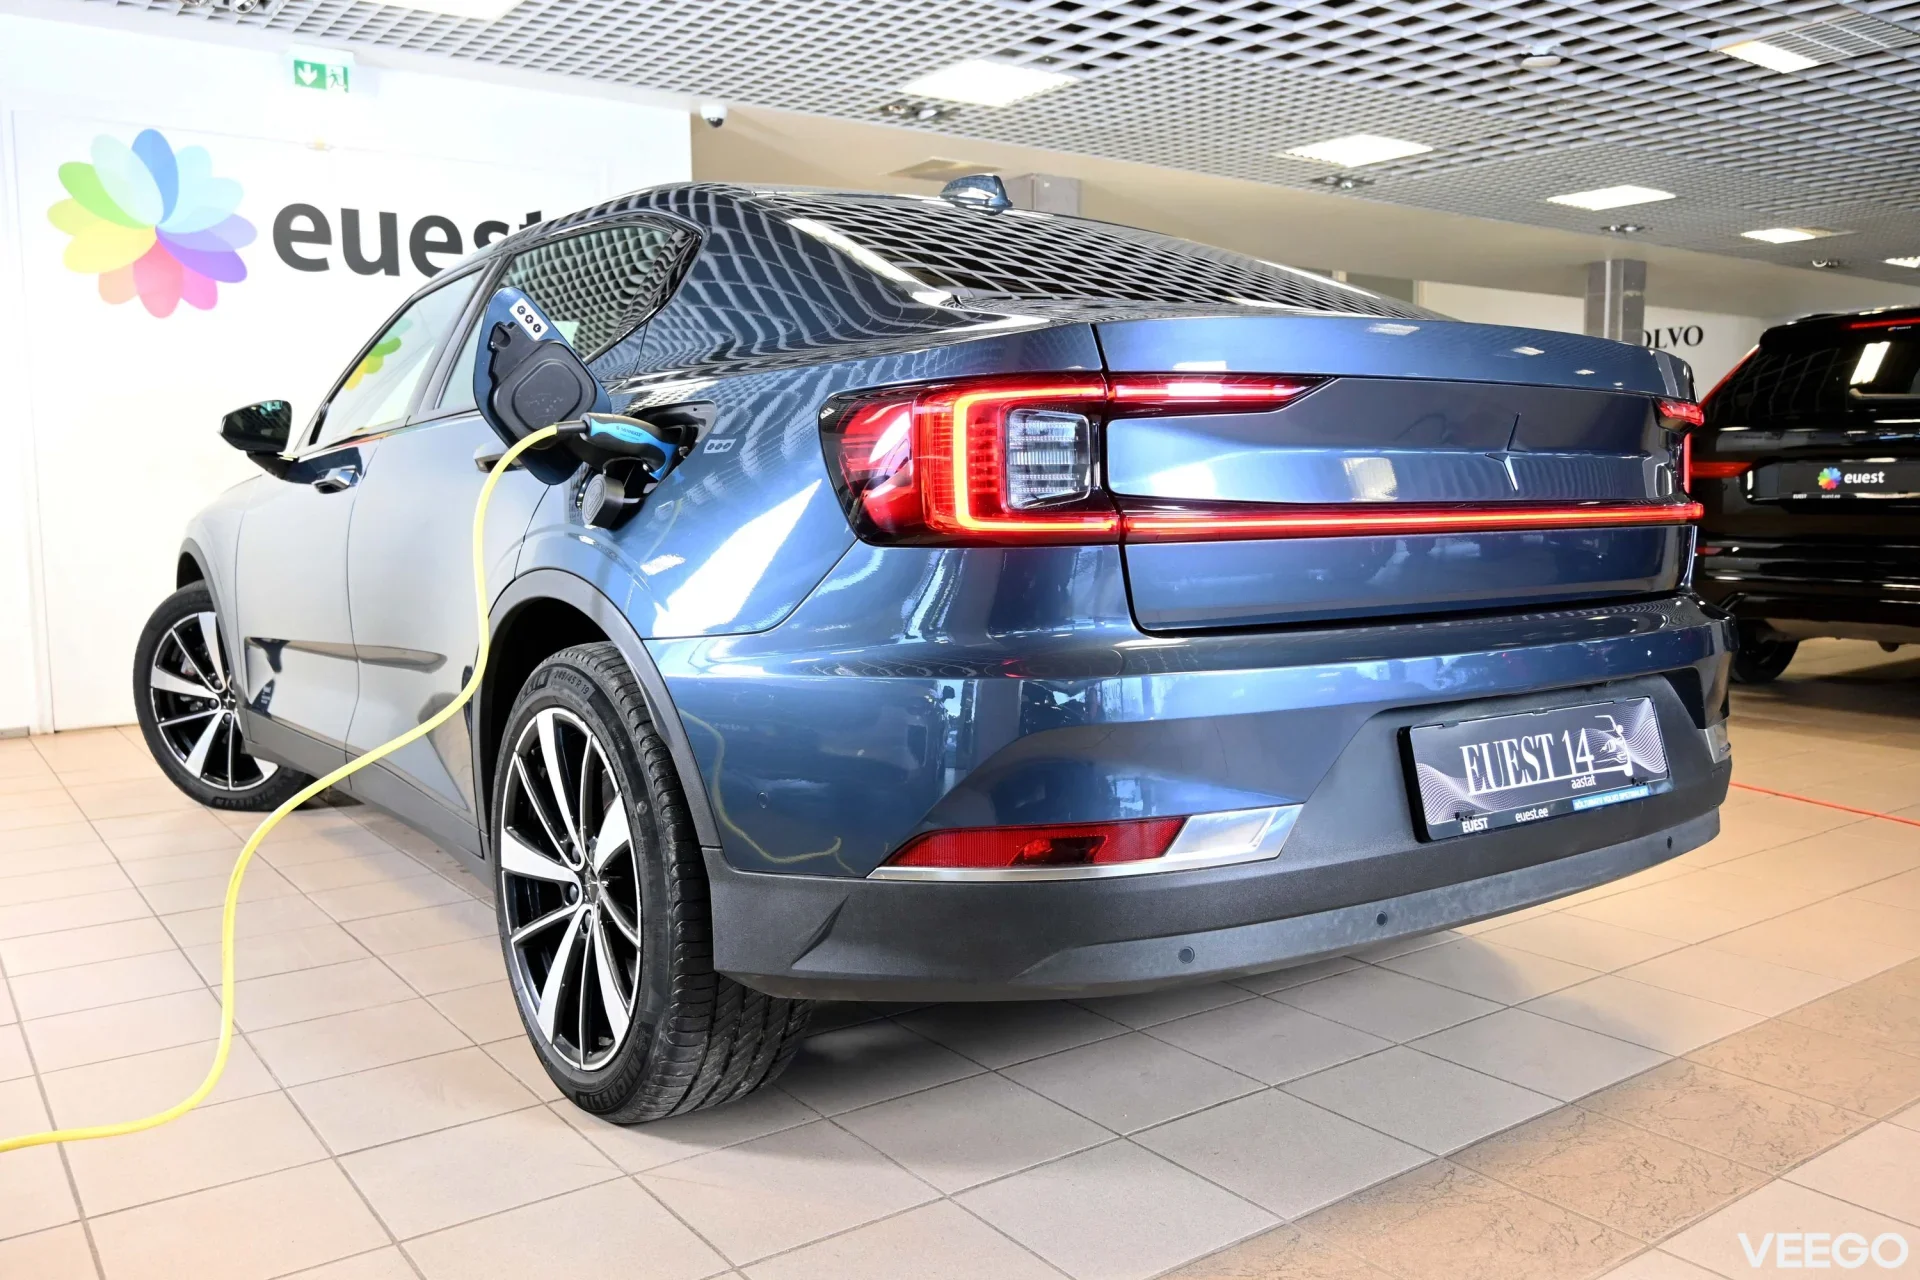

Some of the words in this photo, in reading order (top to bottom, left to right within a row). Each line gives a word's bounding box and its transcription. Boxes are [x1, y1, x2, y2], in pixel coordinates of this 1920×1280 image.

[272, 202, 542, 279] eue
[1643, 325, 1704, 349] LVO
[1844, 471, 1885, 484] euest
[553, 670, 578, 686] 245/45
[581, 684, 590, 695] 19
[1459, 733, 1554, 795] EUEST
[1561, 727, 1595, 776] 14
[1571, 774, 1597, 789] aastat
[1461, 817, 1489, 833] EUEST
[1515, 807, 1549, 823] euest.ee
[578, 1052, 642, 1110] MICHELIN
